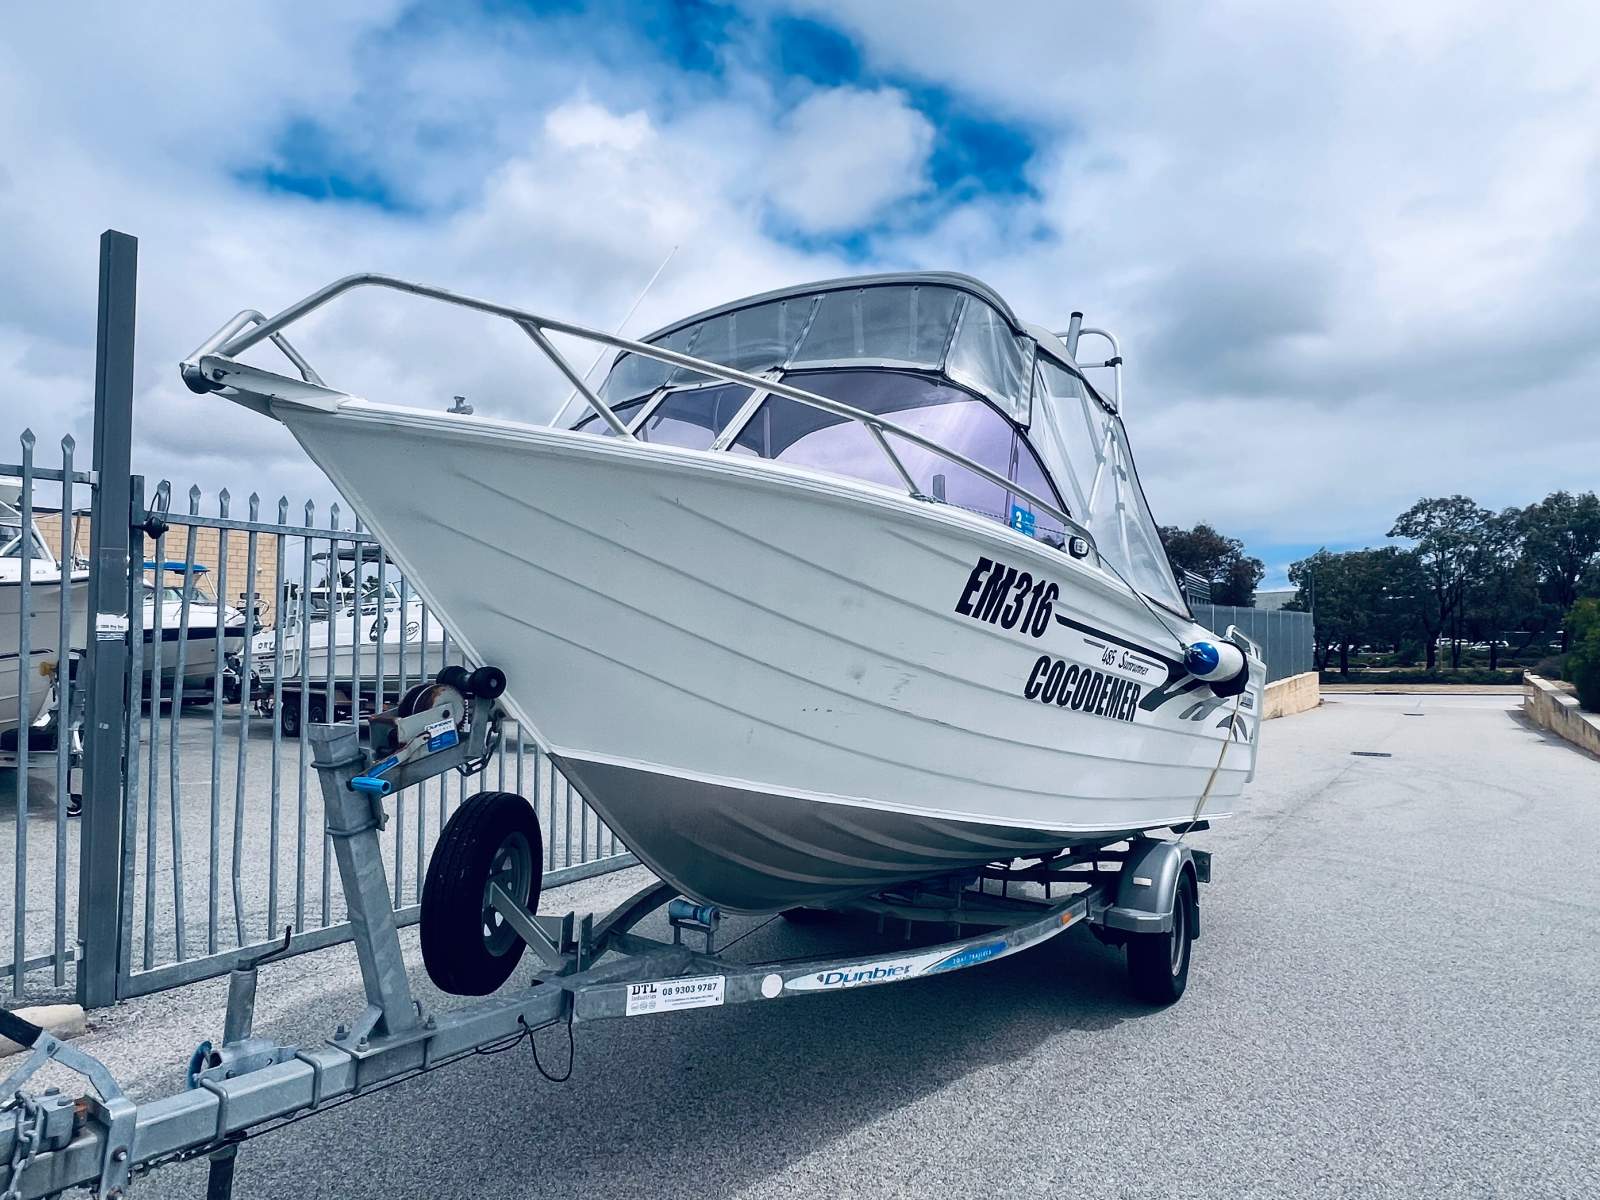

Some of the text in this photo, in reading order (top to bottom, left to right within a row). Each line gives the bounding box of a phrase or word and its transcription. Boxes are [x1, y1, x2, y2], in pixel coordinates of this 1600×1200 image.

[955, 556, 1060, 639] EM316
[1024, 655, 1142, 723] COCODEMER
[823, 964, 912, 985] Dunbier
[632, 984, 657, 995] DTL
[662, 982, 718, 996] 08 9303 9787
